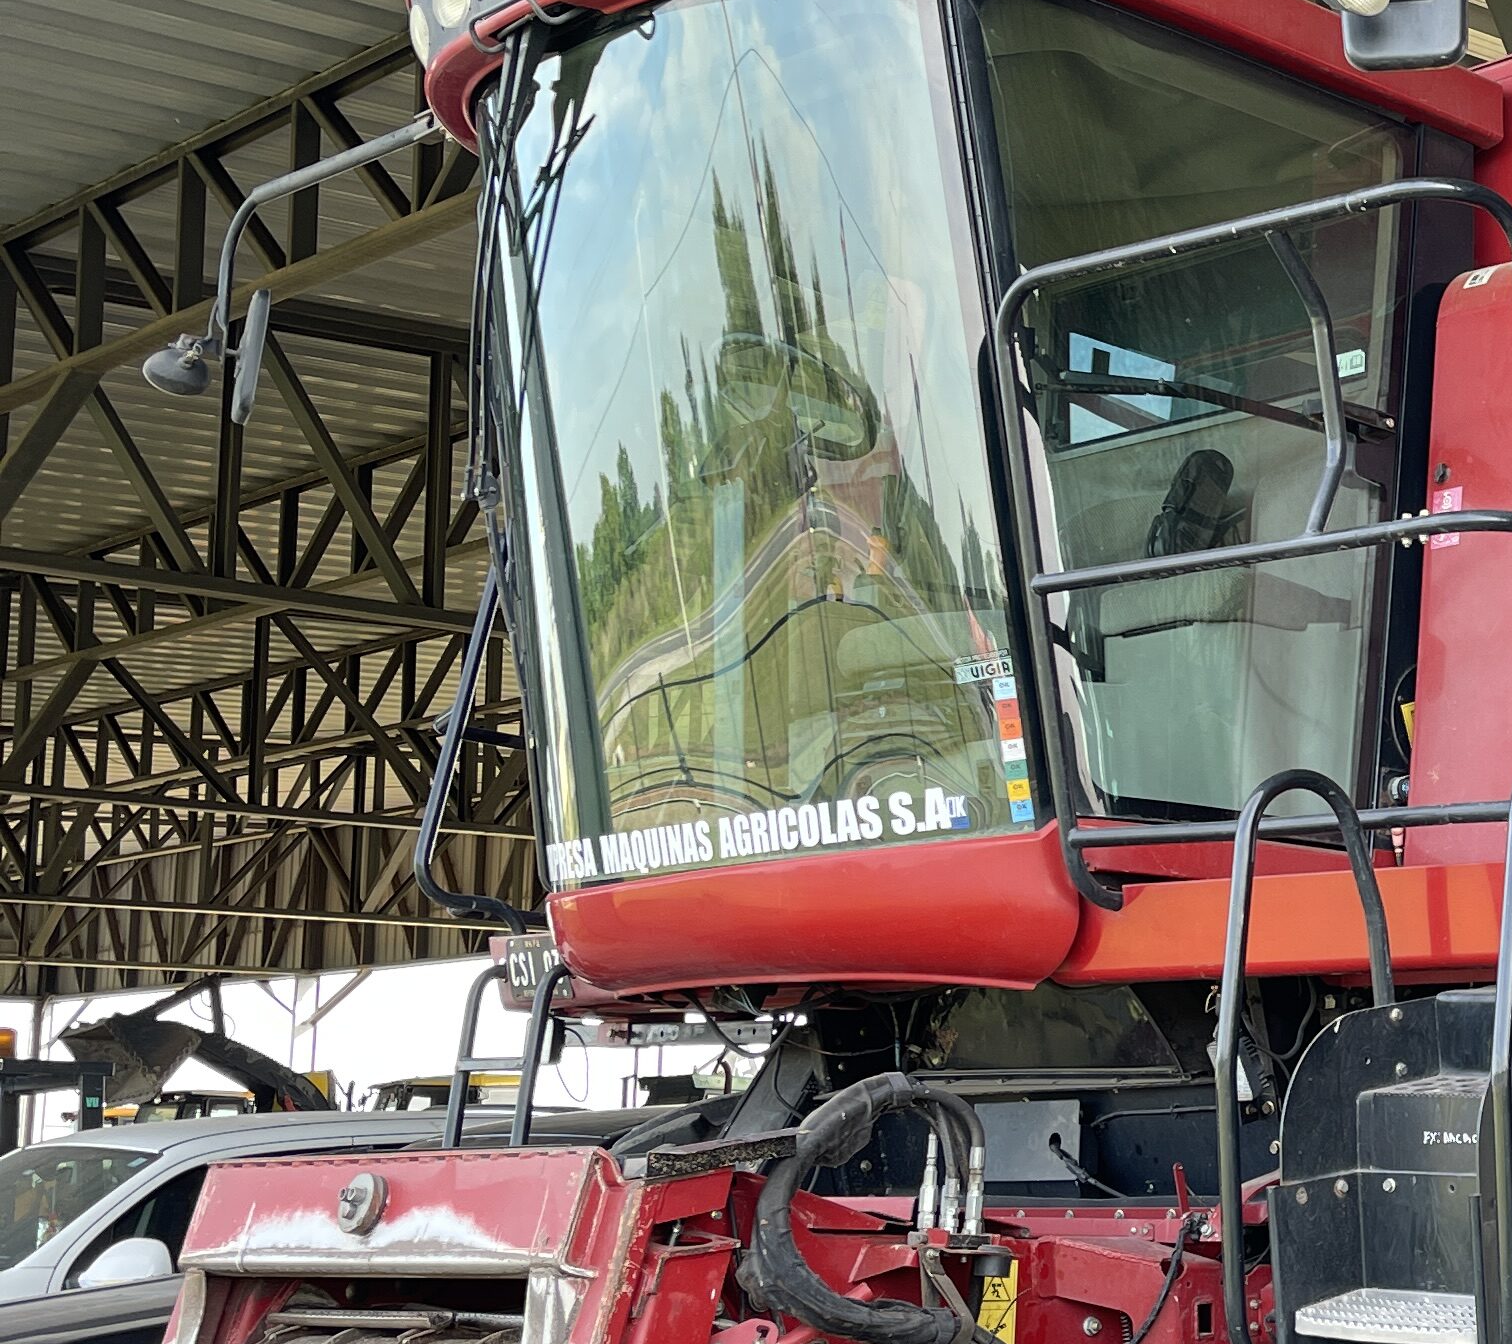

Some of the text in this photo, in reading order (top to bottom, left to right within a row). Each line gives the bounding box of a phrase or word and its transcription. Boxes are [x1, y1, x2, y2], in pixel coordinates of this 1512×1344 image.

[599, 820, 714, 874] MAQUINAS
[718, 795, 884, 859] AGRICOLAS
[509, 951, 537, 987] CSI
